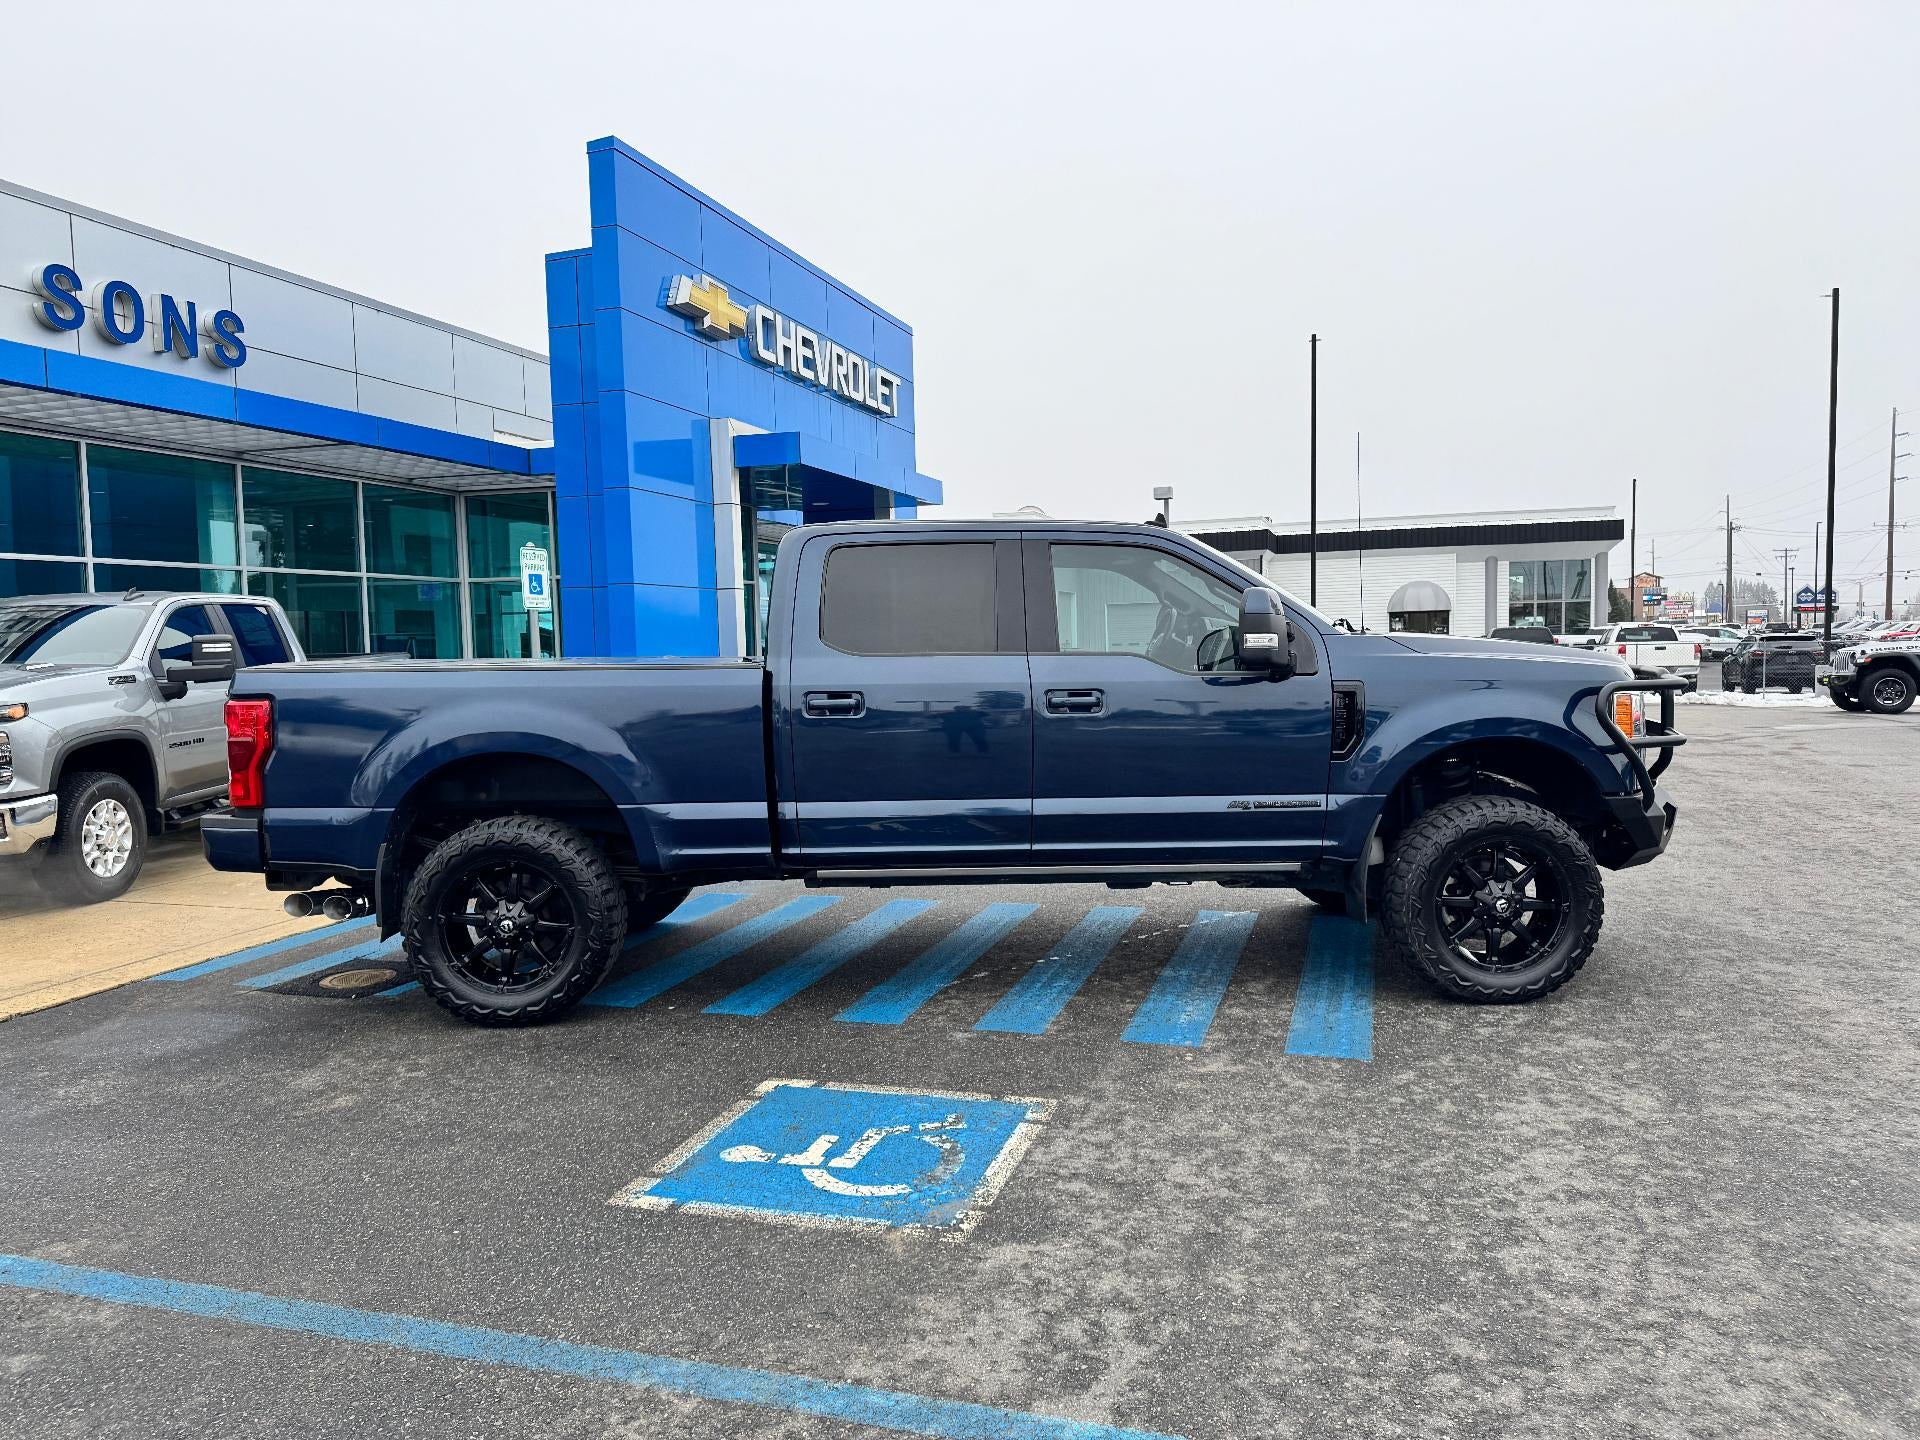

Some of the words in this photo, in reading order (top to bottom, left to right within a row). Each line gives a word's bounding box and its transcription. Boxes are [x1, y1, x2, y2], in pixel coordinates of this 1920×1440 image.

[33, 263, 247, 369] SONS
[748, 303, 901, 418] CHEVROLET
[522, 551, 546, 562] RESERVED
[524, 562, 545, 572] PARKING
[168, 740, 192, 749] 2500
[192, 737, 205, 745] HD
